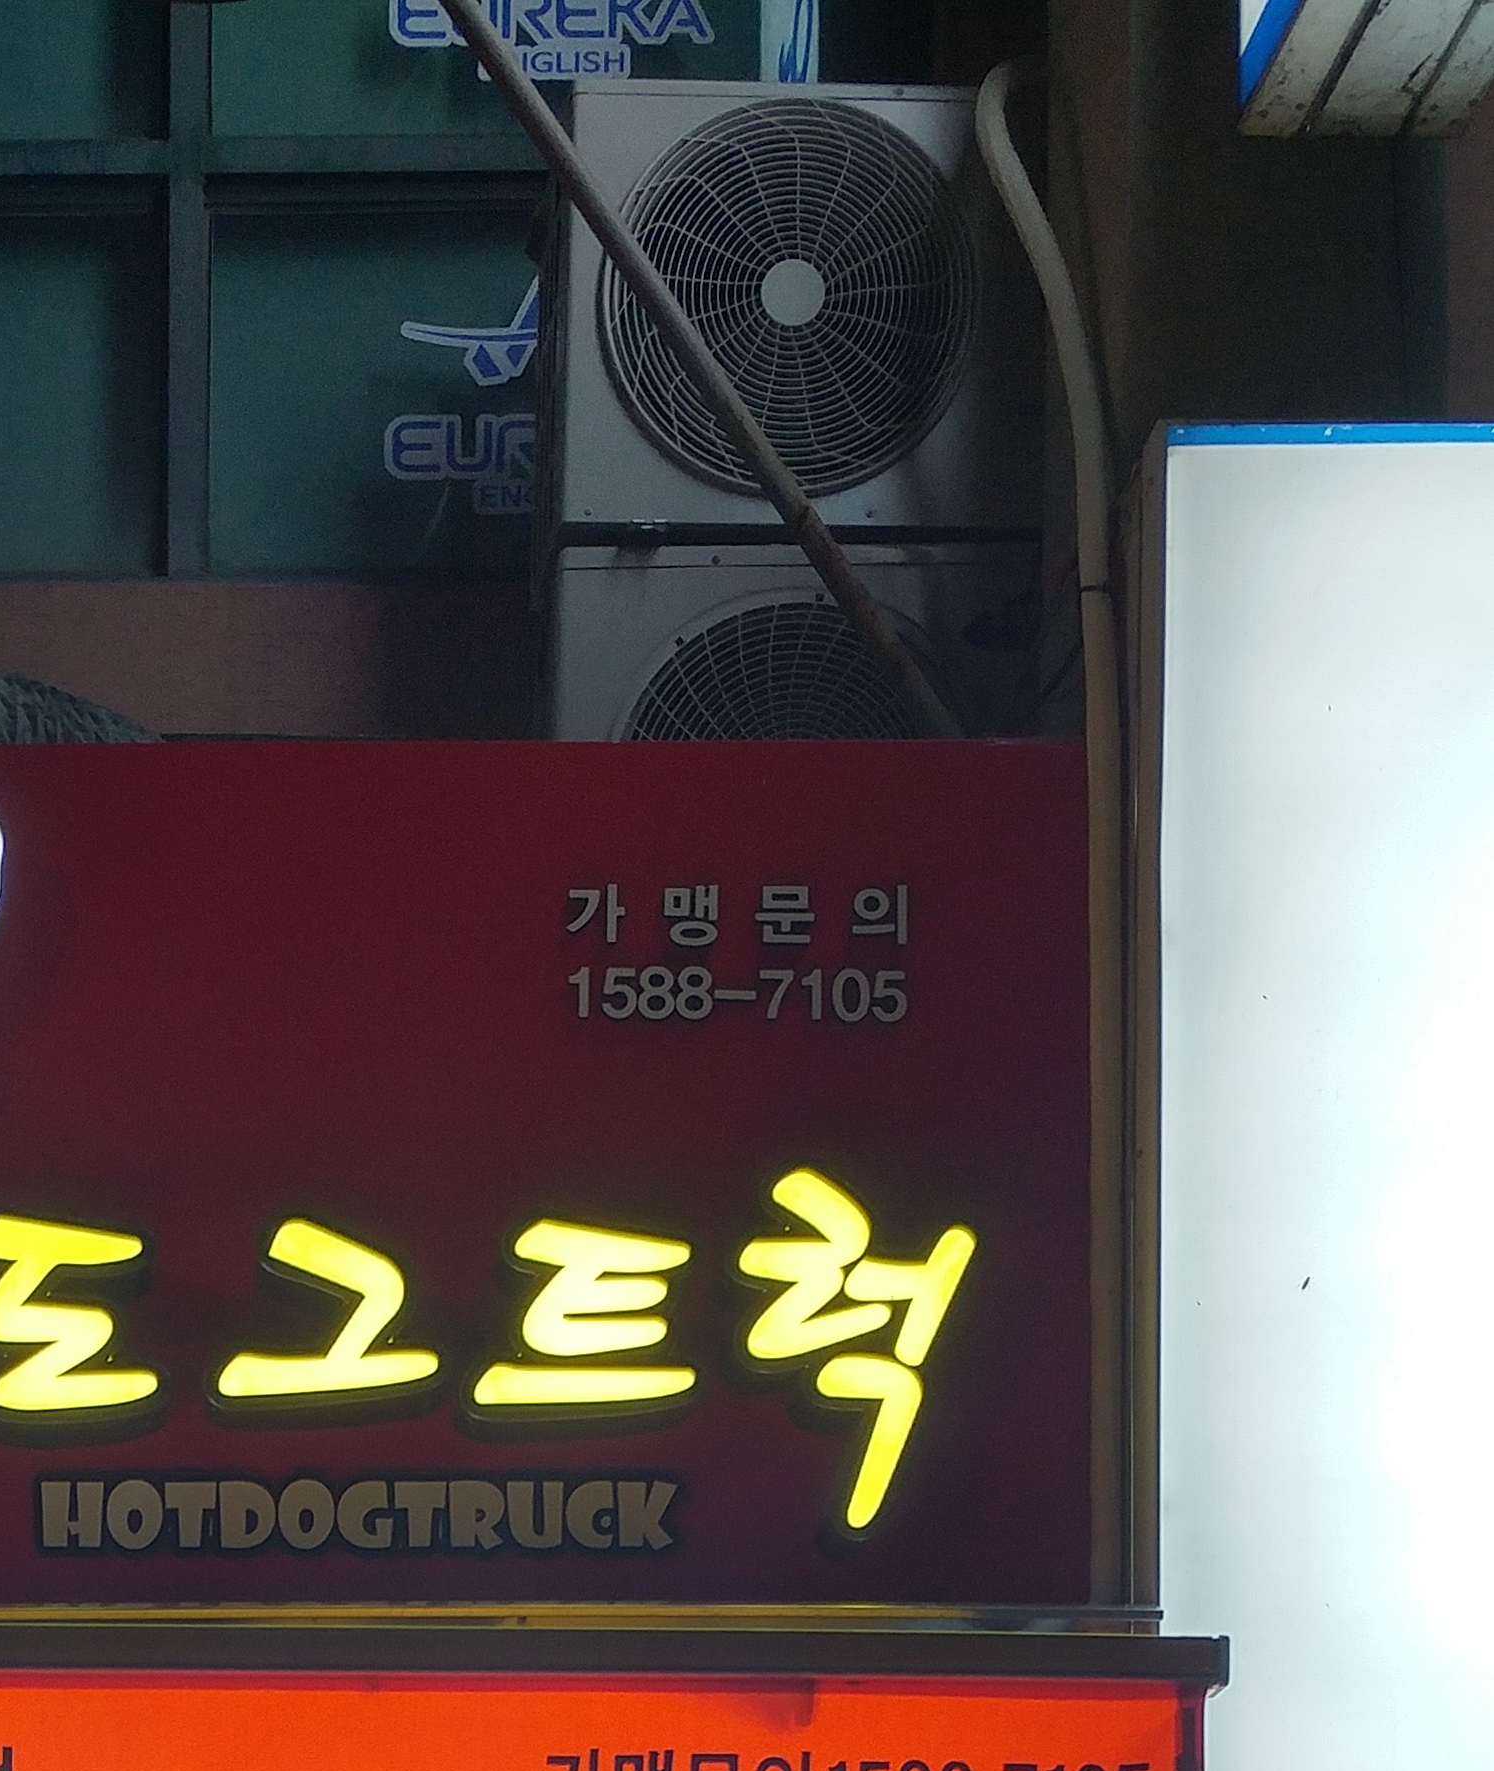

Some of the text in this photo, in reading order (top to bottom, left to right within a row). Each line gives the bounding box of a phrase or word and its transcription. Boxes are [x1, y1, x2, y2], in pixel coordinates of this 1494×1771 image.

[521, 51, 625, 74] GLISH
[392, 420, 535, 472] EUR
[567, 965, 908, 1022] 1588-7105
[39, 1477, 677, 1555] HOTDOGTRUCK
